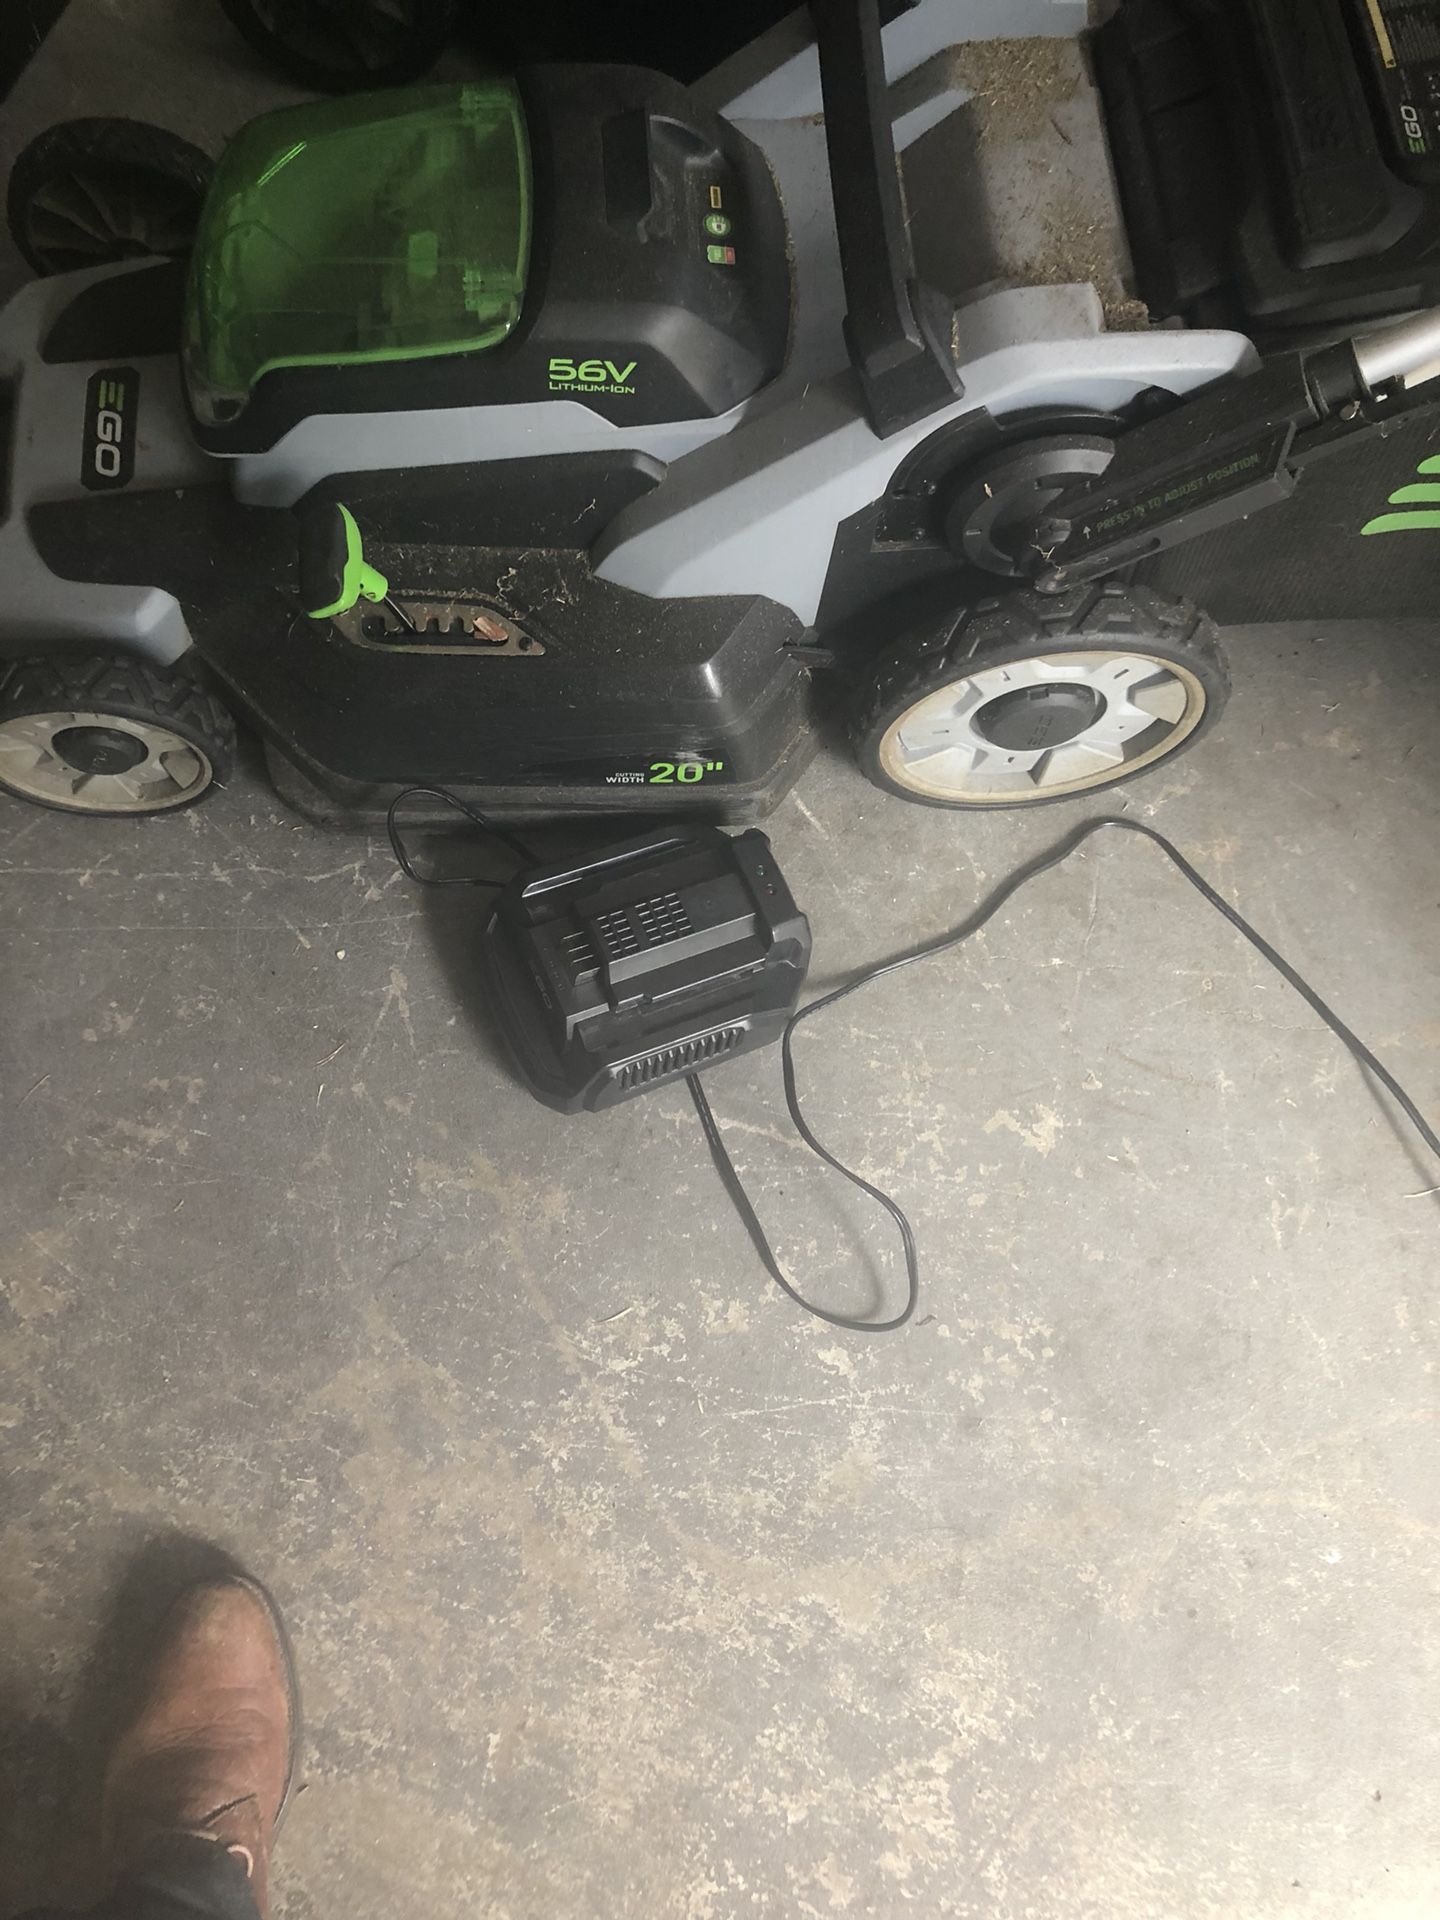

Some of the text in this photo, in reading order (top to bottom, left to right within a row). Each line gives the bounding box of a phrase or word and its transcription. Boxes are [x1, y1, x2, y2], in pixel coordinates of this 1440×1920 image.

[1400, 105, 1426, 153] EGO
[549, 358, 637, 383] 56V
[95, 380, 124, 477] EGO
[1096, 510, 1131, 533] PRESS
[1148, 496, 1162, 510] TO
[1164, 478, 1204, 502] ADJUST
[1206, 453, 1259, 483] POSITION
[649, 762, 723, 783] 20"
